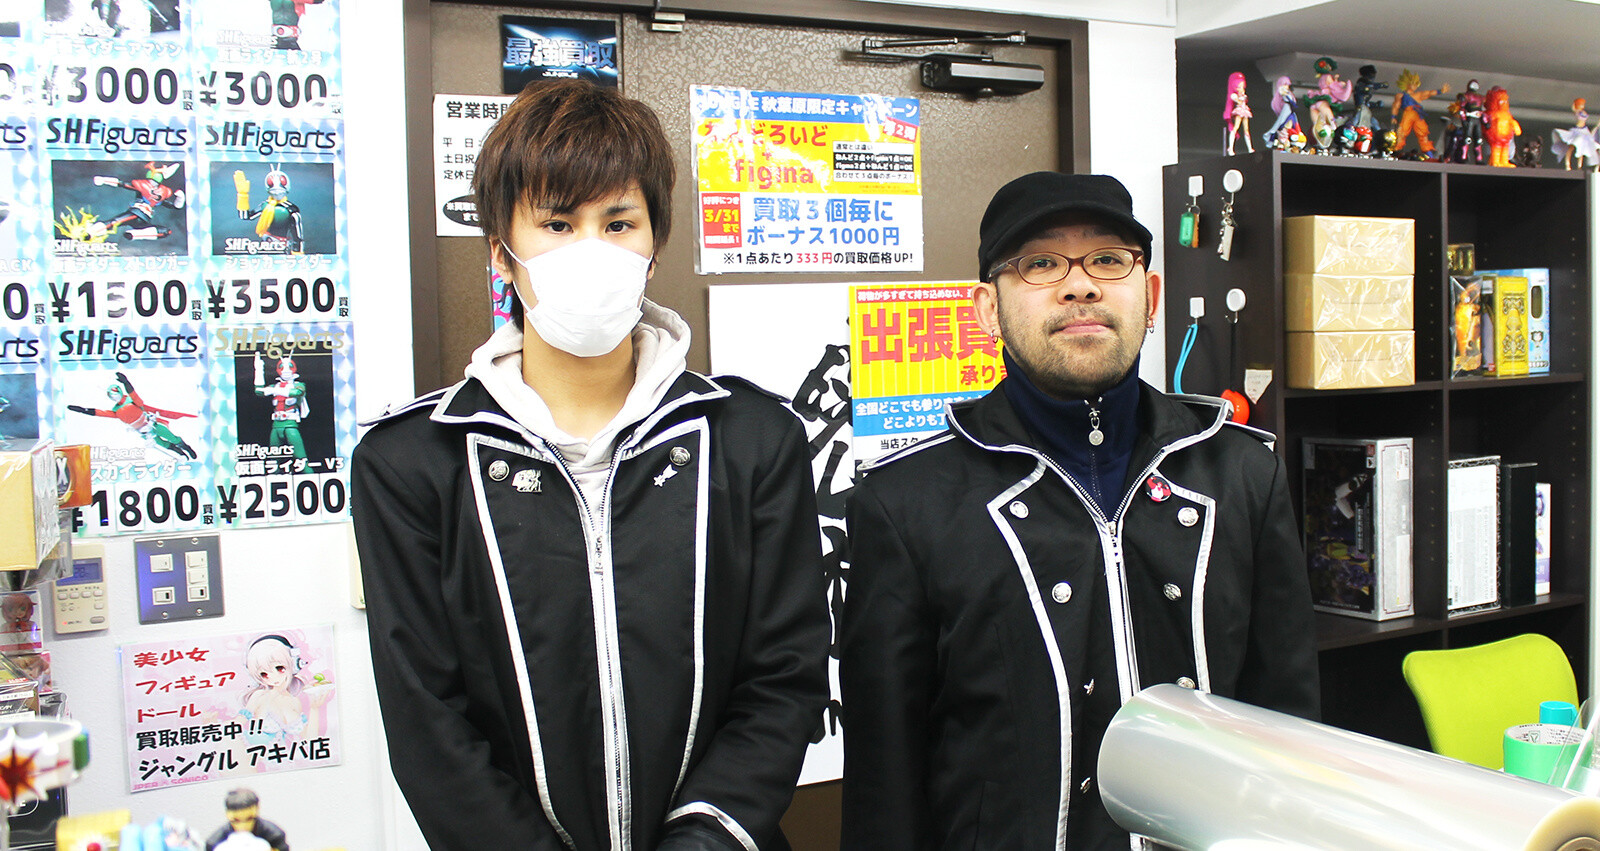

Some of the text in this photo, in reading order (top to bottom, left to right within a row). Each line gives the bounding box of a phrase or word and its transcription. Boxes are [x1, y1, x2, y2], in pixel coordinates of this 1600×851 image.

[506, 37, 614, 69] 最強買取
[443, 170, 474, 180] 定休日
[735, 159, 814, 190] figma
[703, 208, 740, 223] 3/31
[753, 198, 893, 223] 買取3個毎に
[747, 225, 900, 246] ボーナス1000円
[206, 277, 335, 318] ¥3500
[91, 462, 192, 481] スカイライダー
[235, 457, 345, 477] 仮面ライダー V3
[217, 478, 346, 524] ¥2500
[134, 647, 210, 668] 美少女
[136, 672, 236, 694] フィギュア
[137, 704, 201, 723] ドール
[136, 722, 242, 751] 買取販売中
[138, 738, 331, 781] ジャングル アキバ店
